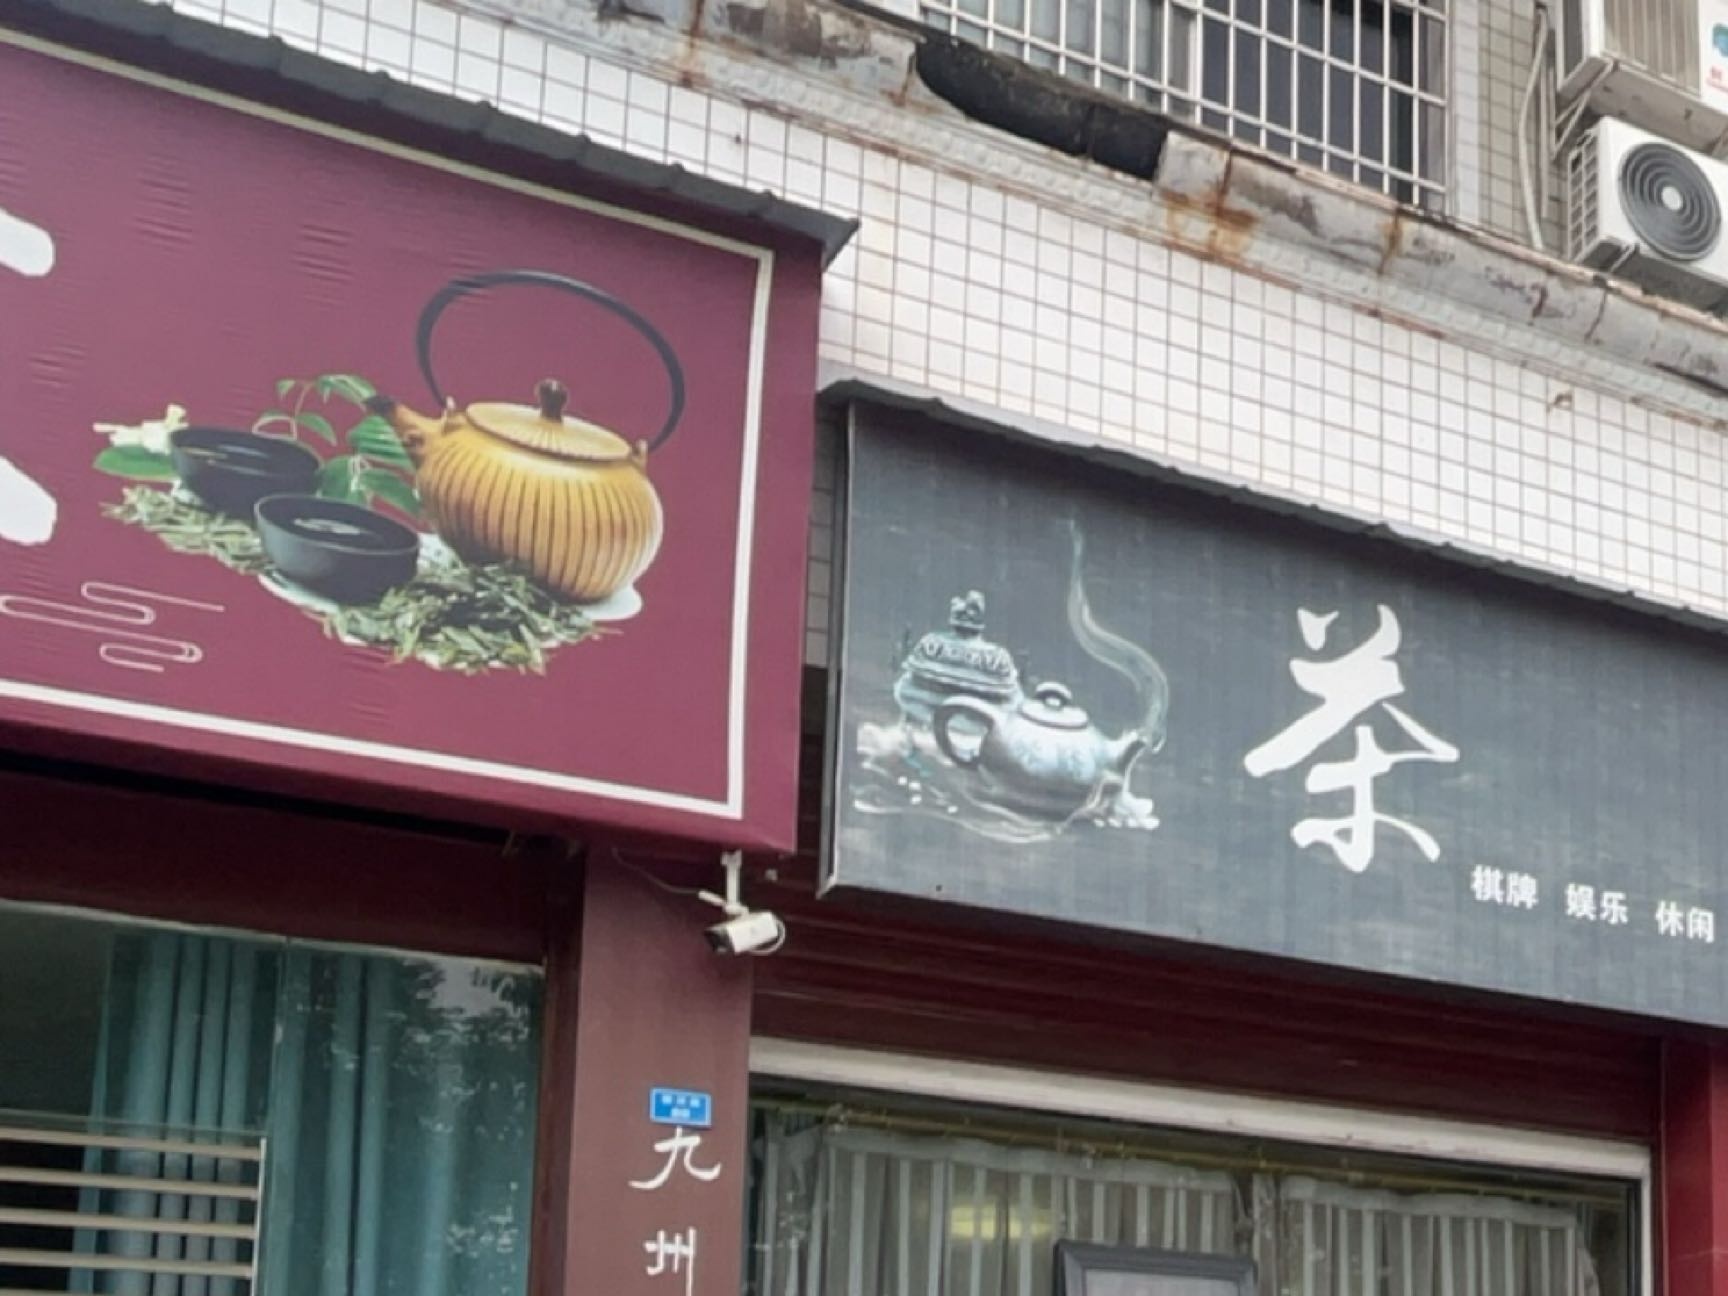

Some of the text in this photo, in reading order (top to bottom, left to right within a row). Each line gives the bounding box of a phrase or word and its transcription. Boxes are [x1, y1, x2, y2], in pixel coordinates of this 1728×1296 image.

[1244, 604, 1460, 872] 茶
[1469, 863, 1539, 909] 棋牌
[1564, 881, 1629, 926] 娱乐
[1654, 899, 1715, 944] 休闲
